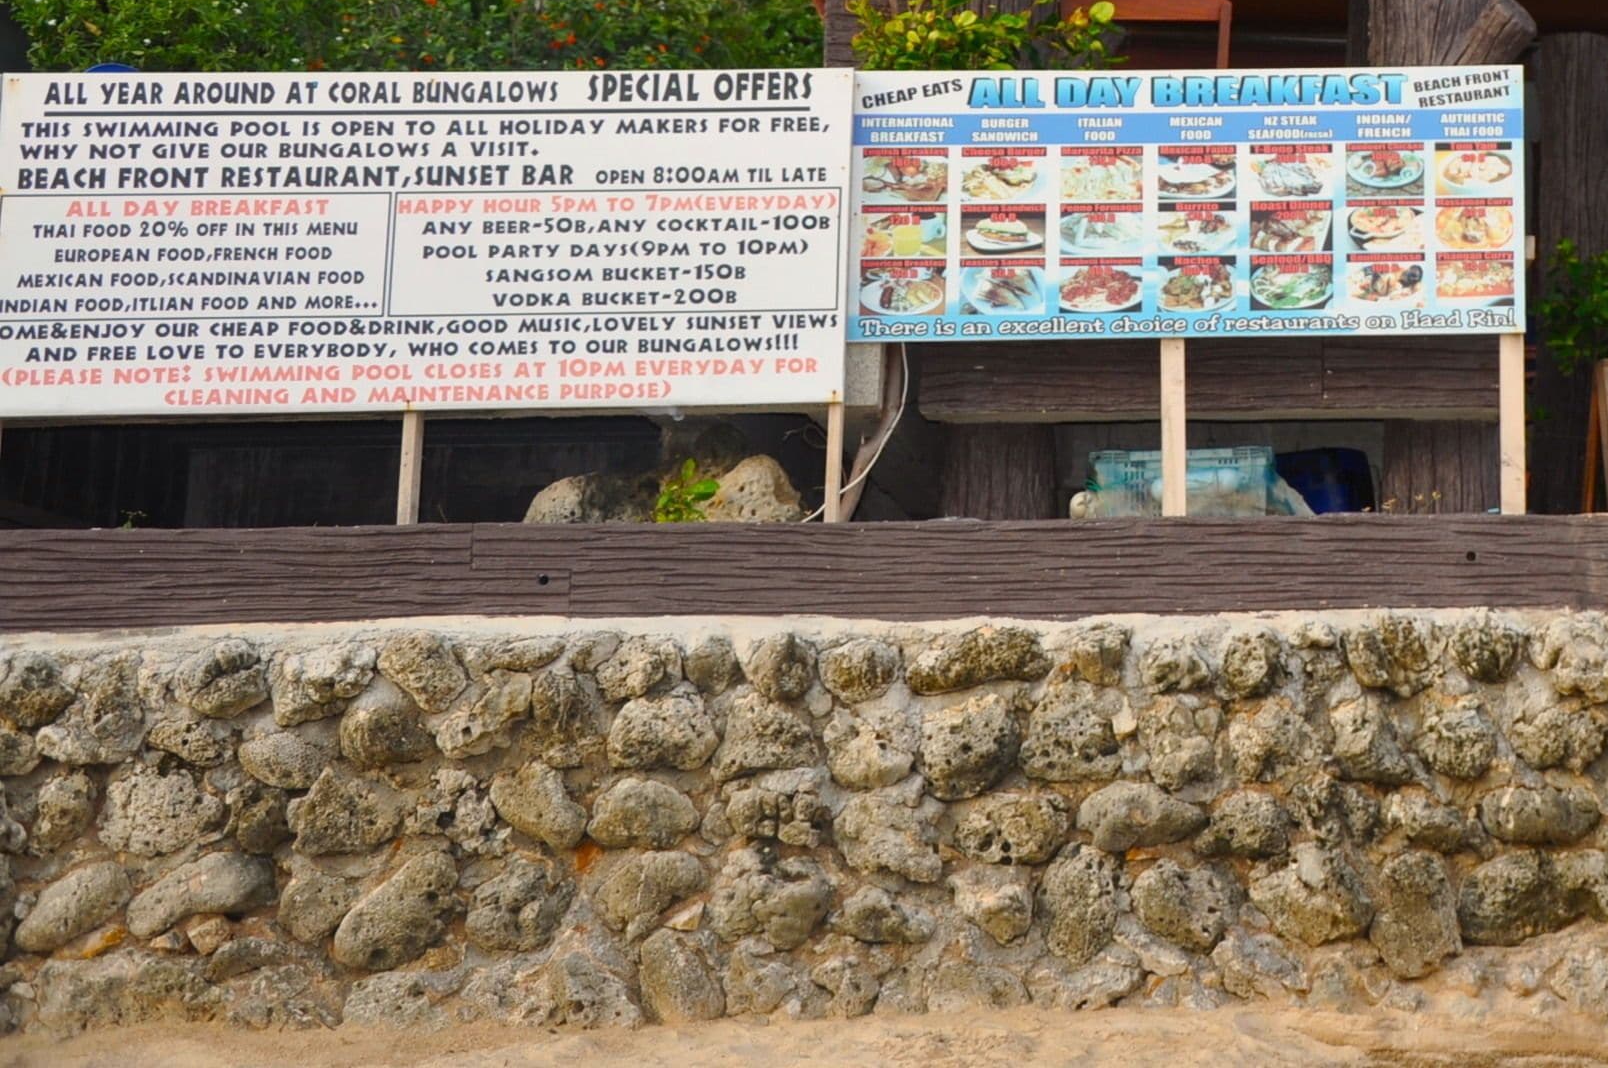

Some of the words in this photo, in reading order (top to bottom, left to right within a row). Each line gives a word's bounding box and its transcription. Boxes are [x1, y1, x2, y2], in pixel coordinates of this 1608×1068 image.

[44, 82, 87, 105] ALL
[101, 82, 163, 104] YEAR
[174, 82, 275, 104] AROUND
[286, 82, 318, 104] AT
[329, 82, 401, 103] CORAL
[413, 80, 558, 103] BUNGALOWS
[588, 73, 699, 102] SPECIAL
[714, 72, 812, 101] OFFERS
[1414, 75, 1461, 93] BEACH
[1465, 69, 1510, 86] FRONT
[862, 87, 919, 109] CHEAP
[923, 78, 963, 98] EATS
[967, 77, 1045, 109] ALL
[1054, 77, 1143, 108] DAY
[1151, 73, 1408, 108] BREAKFAST
[1418, 85, 1510, 108] RESTAURANT
[862, 118, 953, 128] INTERNATIONAL
[981, 118, 1029, 129] BURGER
[1078, 118, 1122, 128] ITALIAN
[1170, 116, 1222, 127] MEXICAN
[1280, 115, 1317, 126] STEAK
[1440, 113, 1504, 124] AUTHENTIC
[21, 122, 70, 138] THIS
[83, 122, 218, 137] SWIMMING
[230, 121, 290, 136] POOL
[303, 121, 320, 136] IS
[332, 121, 394, 136] OPEN
[406, 121, 435, 135] TO
[447, 120, 488, 135] ALL
[500, 120, 604, 135] HOLIDAY
[616, 119, 707, 134] MAKERS
[719, 118, 760, 132] FOR
[771, 117, 829, 132] FREE,
[1084, 131, 1115, 141] FOOD
[1180, 129, 1211, 140] FOOD
[1358, 127, 1411, 138] FRENCH
[1444, 126, 1470, 137] THAI
[1473, 126, 1503, 137] FOOD
[870, 131, 945, 142] BREAKFAST
[972, 131, 1037, 142] SANDWICH
[20, 144, 78, 159] WHY
[89, 144, 141, 159] NOT
[152, 143, 209, 159] GIVE
[221, 143, 267, 158] OUR
[279, 143, 429, 158] BUNGALOWS
[441, 142, 457, 157] A
[470, 142, 538, 156] VISIT.
[18, 168, 106, 189] BEACH
[118, 167, 209, 188] FRONT
[522, 165, 573, 185] BAR
[596, 170, 644, 184] OPEN
[653, 167, 739, 183] 8:00AM
[748, 168, 772, 182] TIL
[782, 168, 826, 182] LATE
[67, 201, 111, 218] ALL
[124, 200, 179, 217] DAY
[191, 199, 329, 216] BREAKFAST
[398, 199, 472, 213] HAPPY
[483, 199, 540, 212] HOUR
[552, 196, 597, 212] 5PM
[608, 197, 634, 211] TO
[33, 224, 75, 238] THAI
[83, 224, 131, 237] FOOD
[140, 221, 188, 237] 20%
[197, 223, 227, 236] OFF
[236, 223, 254, 236] IN
[263, 223, 297, 236] THIS
[307, 222, 357, 235] MENU
[423, 246, 477, 259] POOL
[489, 245, 559, 258] PARTY
[700, 243, 726, 255] TO
[738, 240, 808, 255] 10PM)
[486, 268, 592, 282] SANGSOM
[0, 299, 67, 313] INDIAN
[201, 297, 248, 310] FOOD
[257, 296, 296, 309] AND
[305, 296, 377, 309] MORE...
[493, 293, 570, 307] VODKA
[859, 318, 928, 337] There
[934, 318, 955, 336] is
[961, 321, 991, 336] an
[999, 318, 1104, 335] excellent
[1110, 316, 1186, 332] choice
[1193, 314, 1222, 333] of
[1224, 314, 1360, 331] restaurants
[1366, 317, 1396, 329] on
[1401, 311, 1463, 330] Haad
[25, 347, 77, 362] AND
[87, 346, 136, 361] FREE
[147, 345, 204, 360] LOVE
[216, 345, 244, 359] TO
[254, 343, 396, 358] EVERYBODY,
[408, 342, 458, 356] WHO
[469, 341, 537, 355] COMES
[549, 340, 576, 354] TO
[586, 340, 627, 353] OUR
[638, 334, 797, 353] BUNGALOWS!!!
[1, 369, 102, 385] (PLEASE
[113, 365, 191, 384] NOTE:
[205, 365, 341, 382] SWIMMING
[352, 364, 412, 381] POOL
[424, 364, 501, 379] CLOSES
[515, 362, 545, 377] AT
[560, 359, 625, 377] 10PM
[635, 359, 763, 376] EVERYDAY
[775, 358, 817, 373] FOR
[165, 389, 289, 405] CLEANING
[302, 388, 356, 403] AND
[370, 384, 548, 403] MAINTENANCE
[560, 382, 671, 399] PURPOSE)
